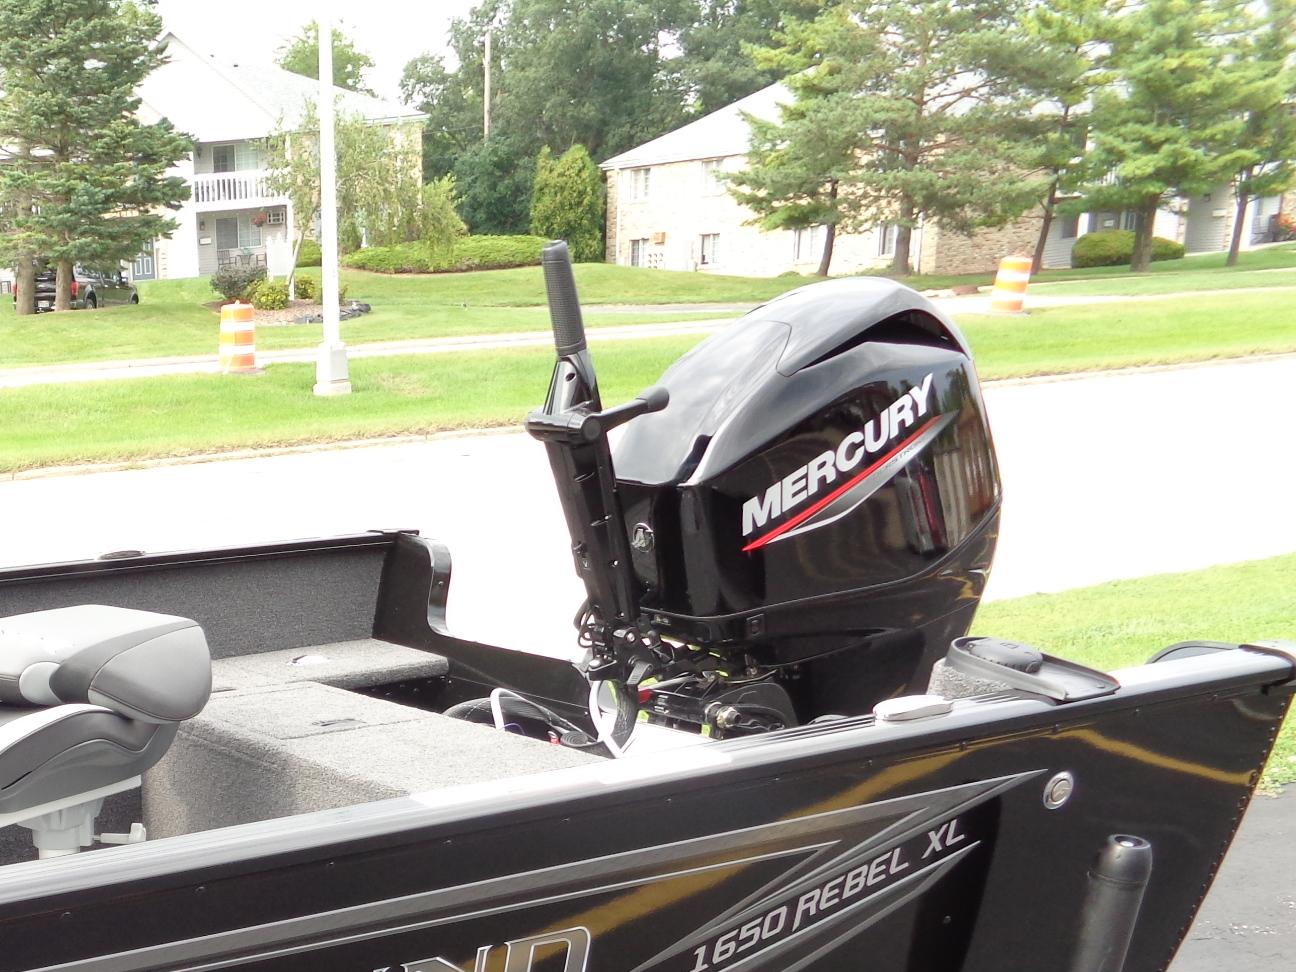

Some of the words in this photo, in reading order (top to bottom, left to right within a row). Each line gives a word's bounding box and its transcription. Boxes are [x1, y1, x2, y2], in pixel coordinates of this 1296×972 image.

[741, 373, 934, 537] MERCURY
[792, 847, 910, 932] REBEL
[922, 818, 967, 860] XL
